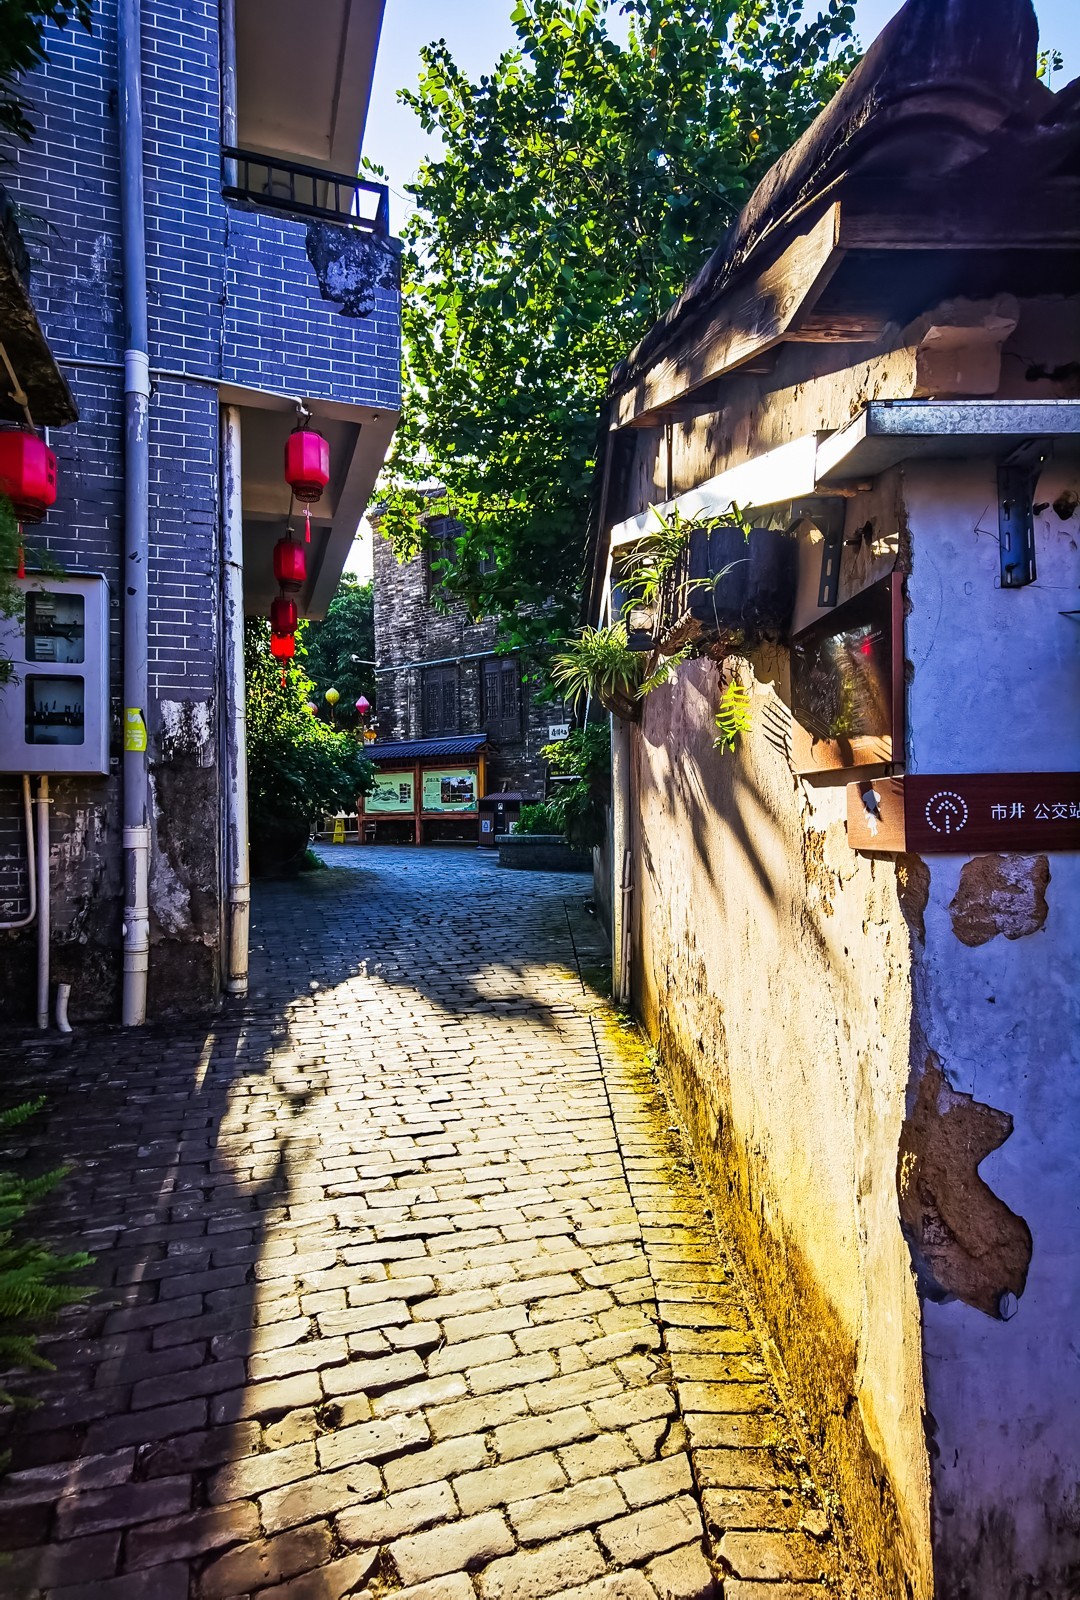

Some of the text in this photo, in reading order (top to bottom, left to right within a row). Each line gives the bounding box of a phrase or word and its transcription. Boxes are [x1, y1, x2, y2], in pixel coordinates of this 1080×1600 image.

[990, 802, 1080, 820] 市井 公交站
